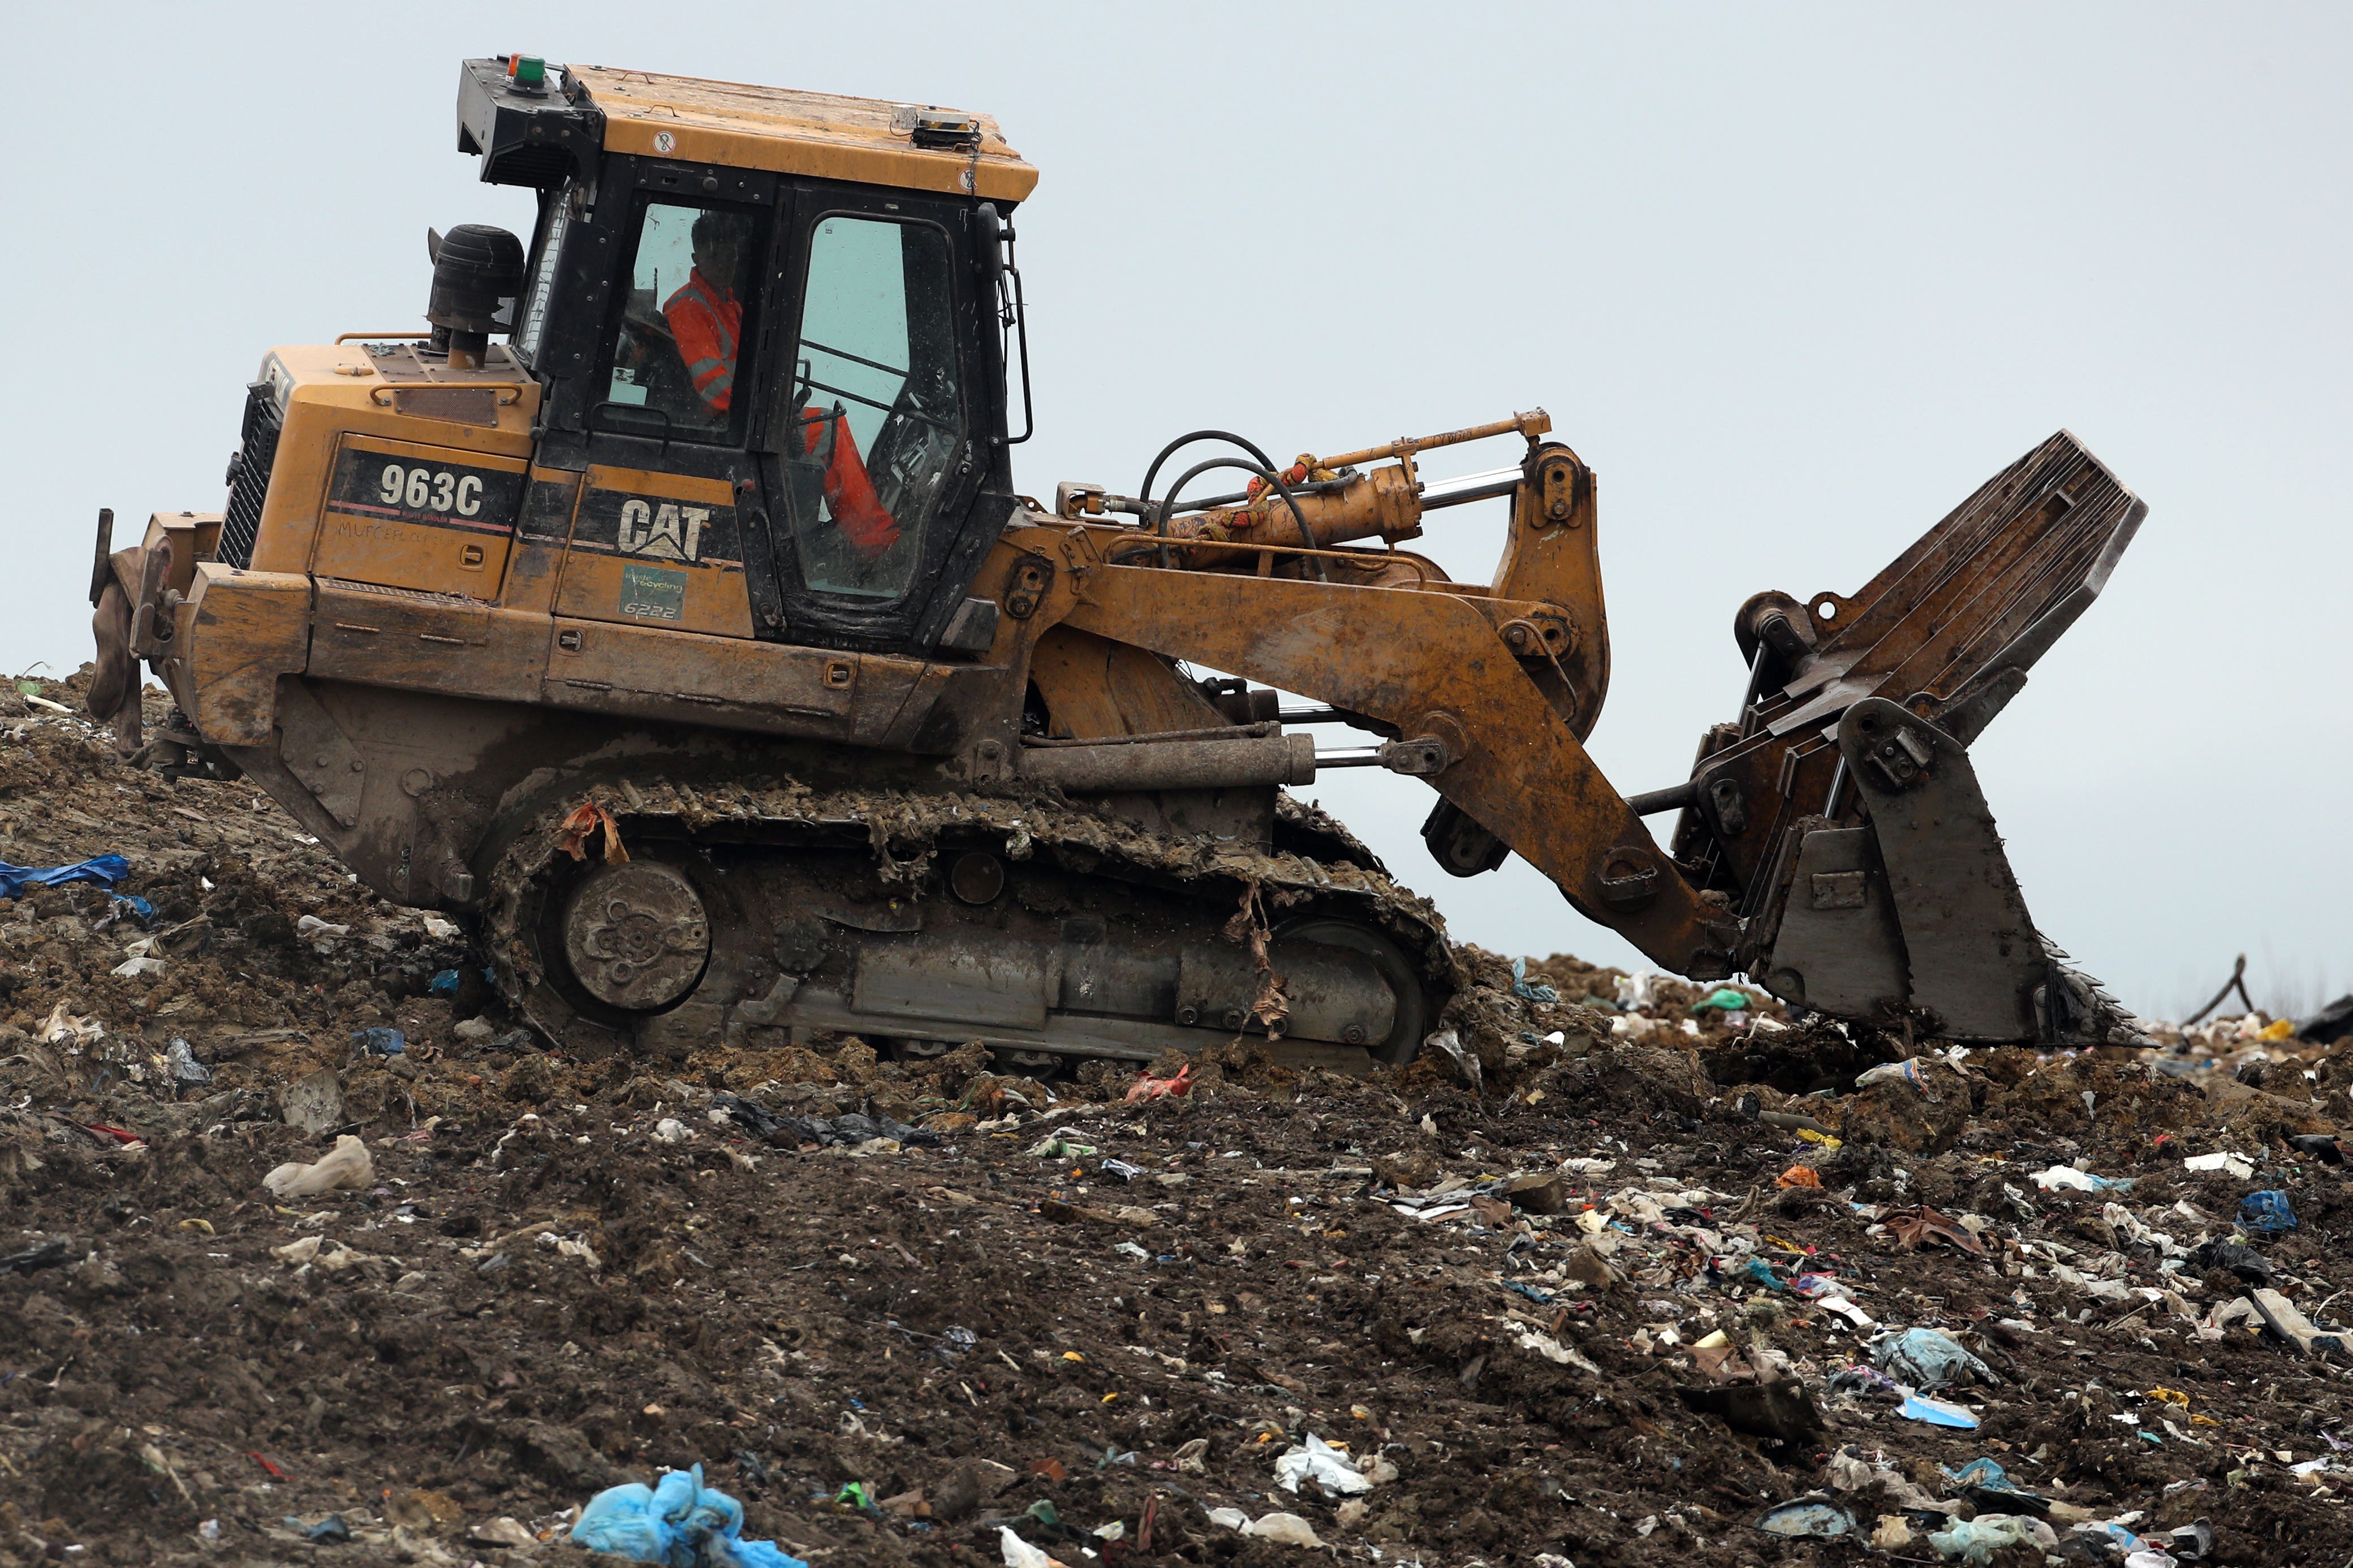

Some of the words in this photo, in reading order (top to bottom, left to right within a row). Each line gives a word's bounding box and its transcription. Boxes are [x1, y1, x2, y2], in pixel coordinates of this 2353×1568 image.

[380, 464, 482, 516] 963C
[618, 500, 710, 561] CAT
[624, 603, 676, 619] 6222
